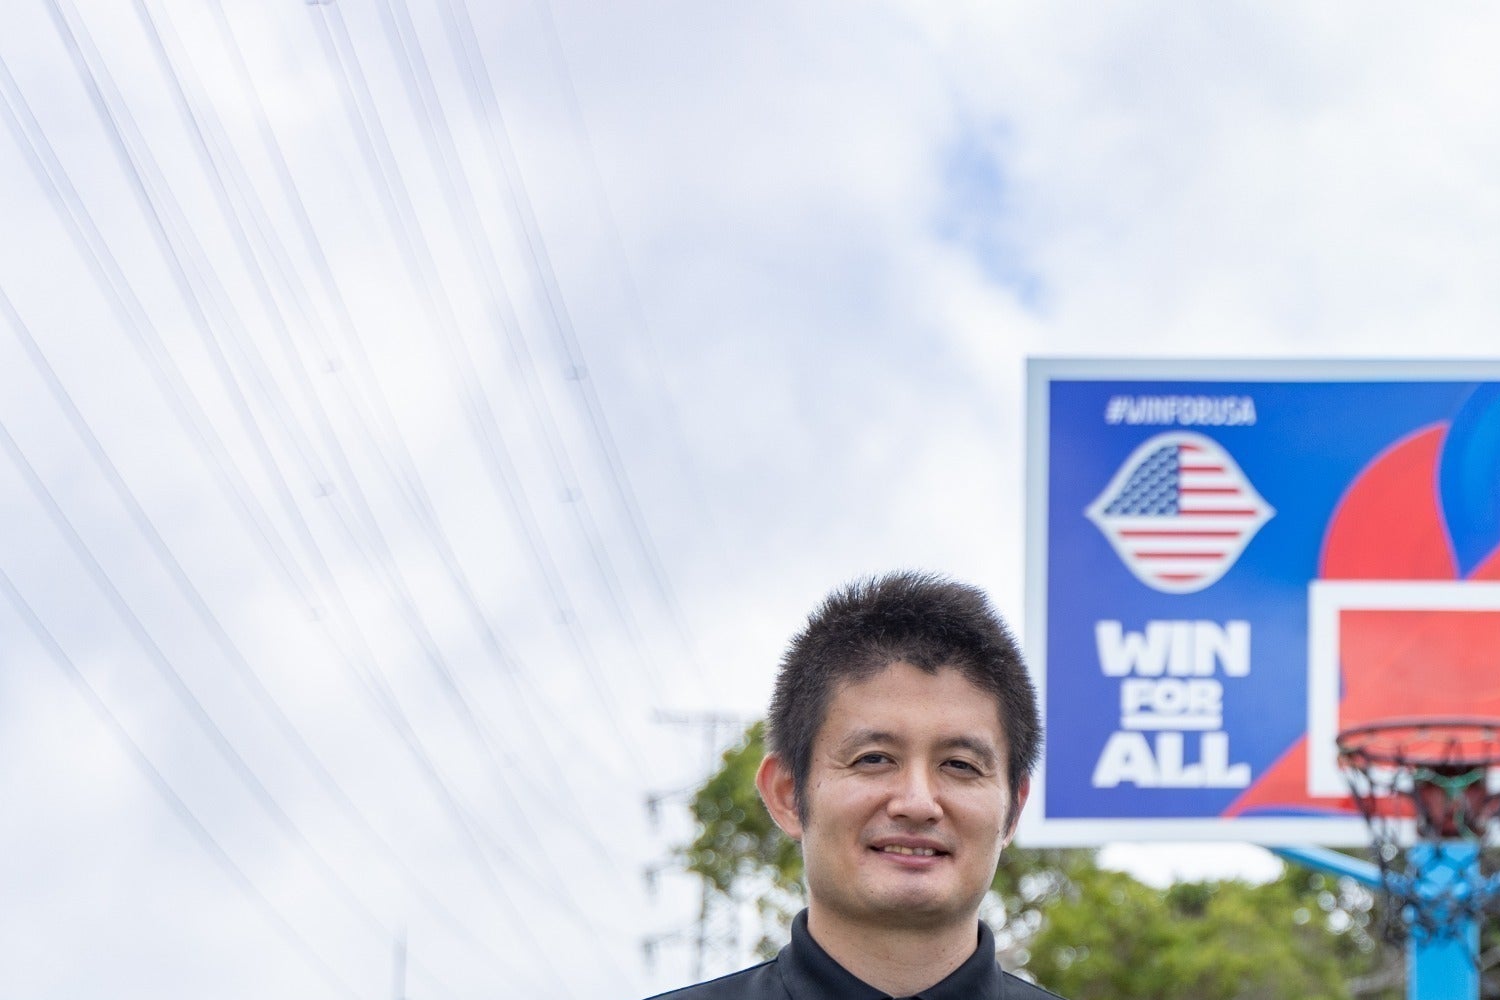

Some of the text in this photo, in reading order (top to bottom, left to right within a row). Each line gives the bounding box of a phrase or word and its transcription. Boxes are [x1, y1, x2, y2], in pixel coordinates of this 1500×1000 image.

[1106, 395, 1257, 426] #WINFORUSA
[1095, 619, 1251, 678] WIN
[1121, 677, 1224, 714] FOR
[1091, 730, 1251, 789] ALL
